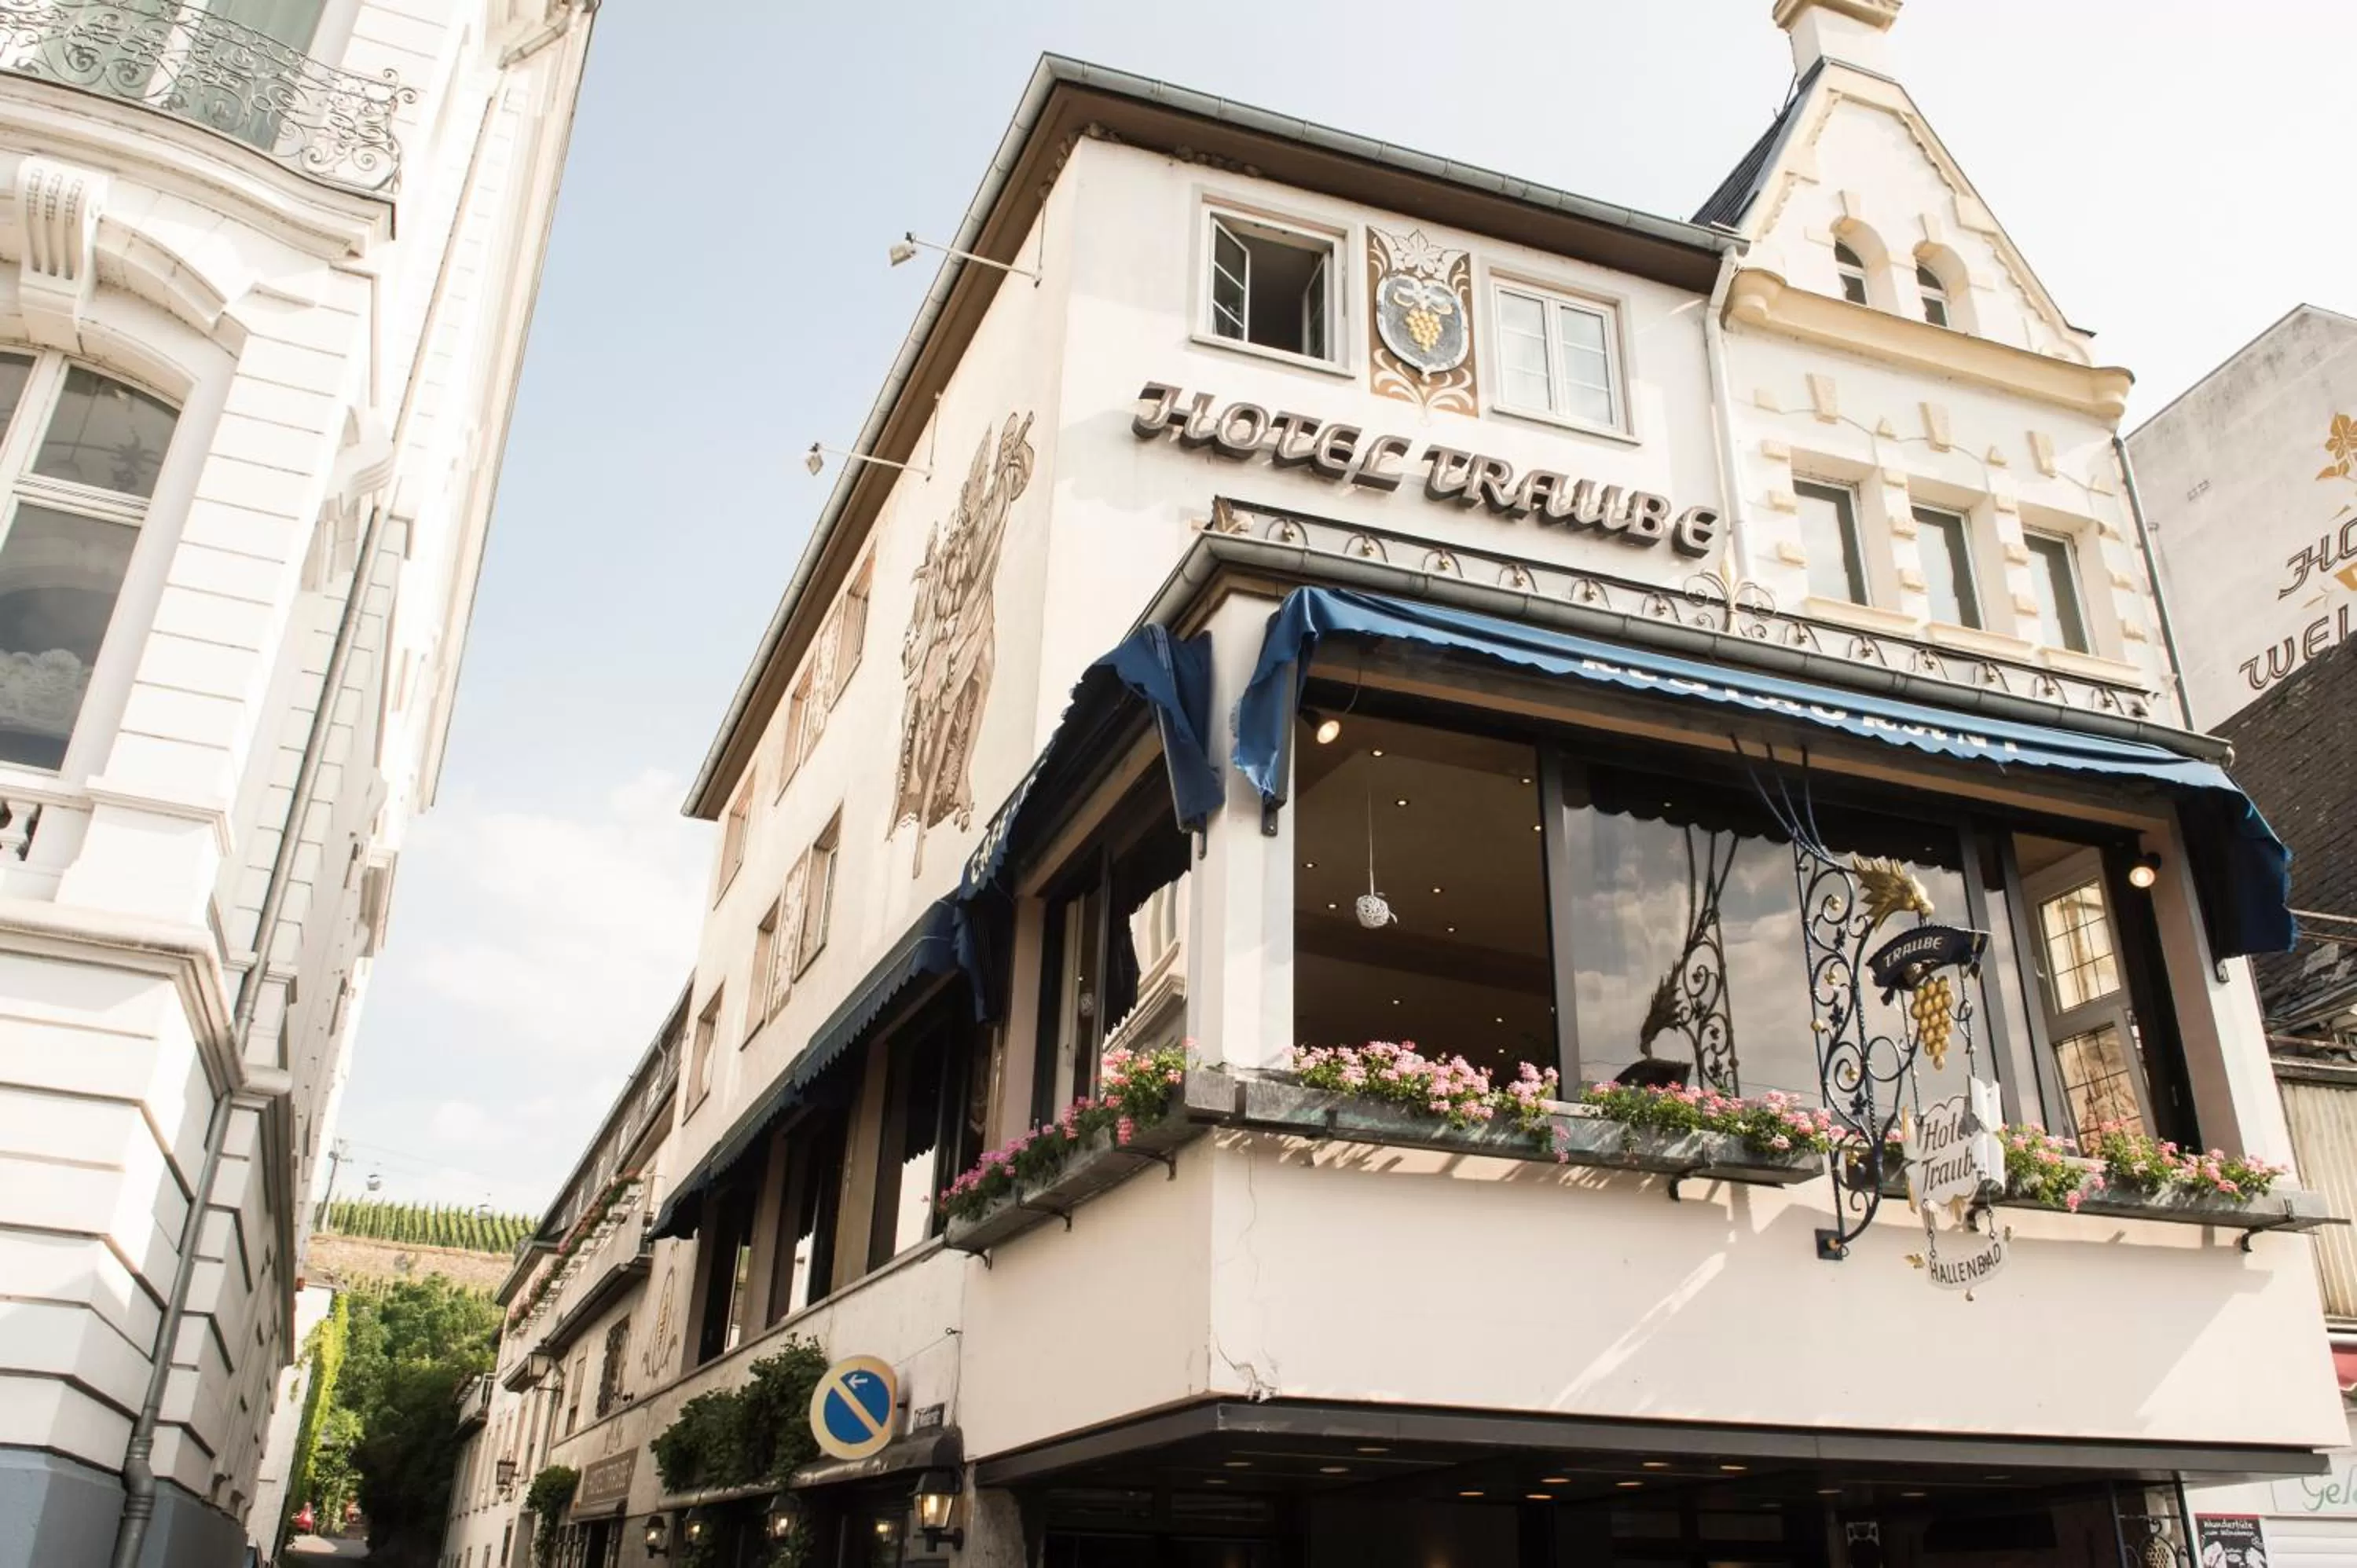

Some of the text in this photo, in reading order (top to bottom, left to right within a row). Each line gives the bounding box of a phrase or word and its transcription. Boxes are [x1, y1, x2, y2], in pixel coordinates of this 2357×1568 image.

[1131, 380, 1721, 559] HOTEL TRAUBE
[1883, 936, 1943, 968] TRAUBE
[1923, 1112, 1973, 1154] Hot
[1921, 1146, 1977, 1193] Traub
[1929, 1242, 2002, 1284] HALLENBAD
